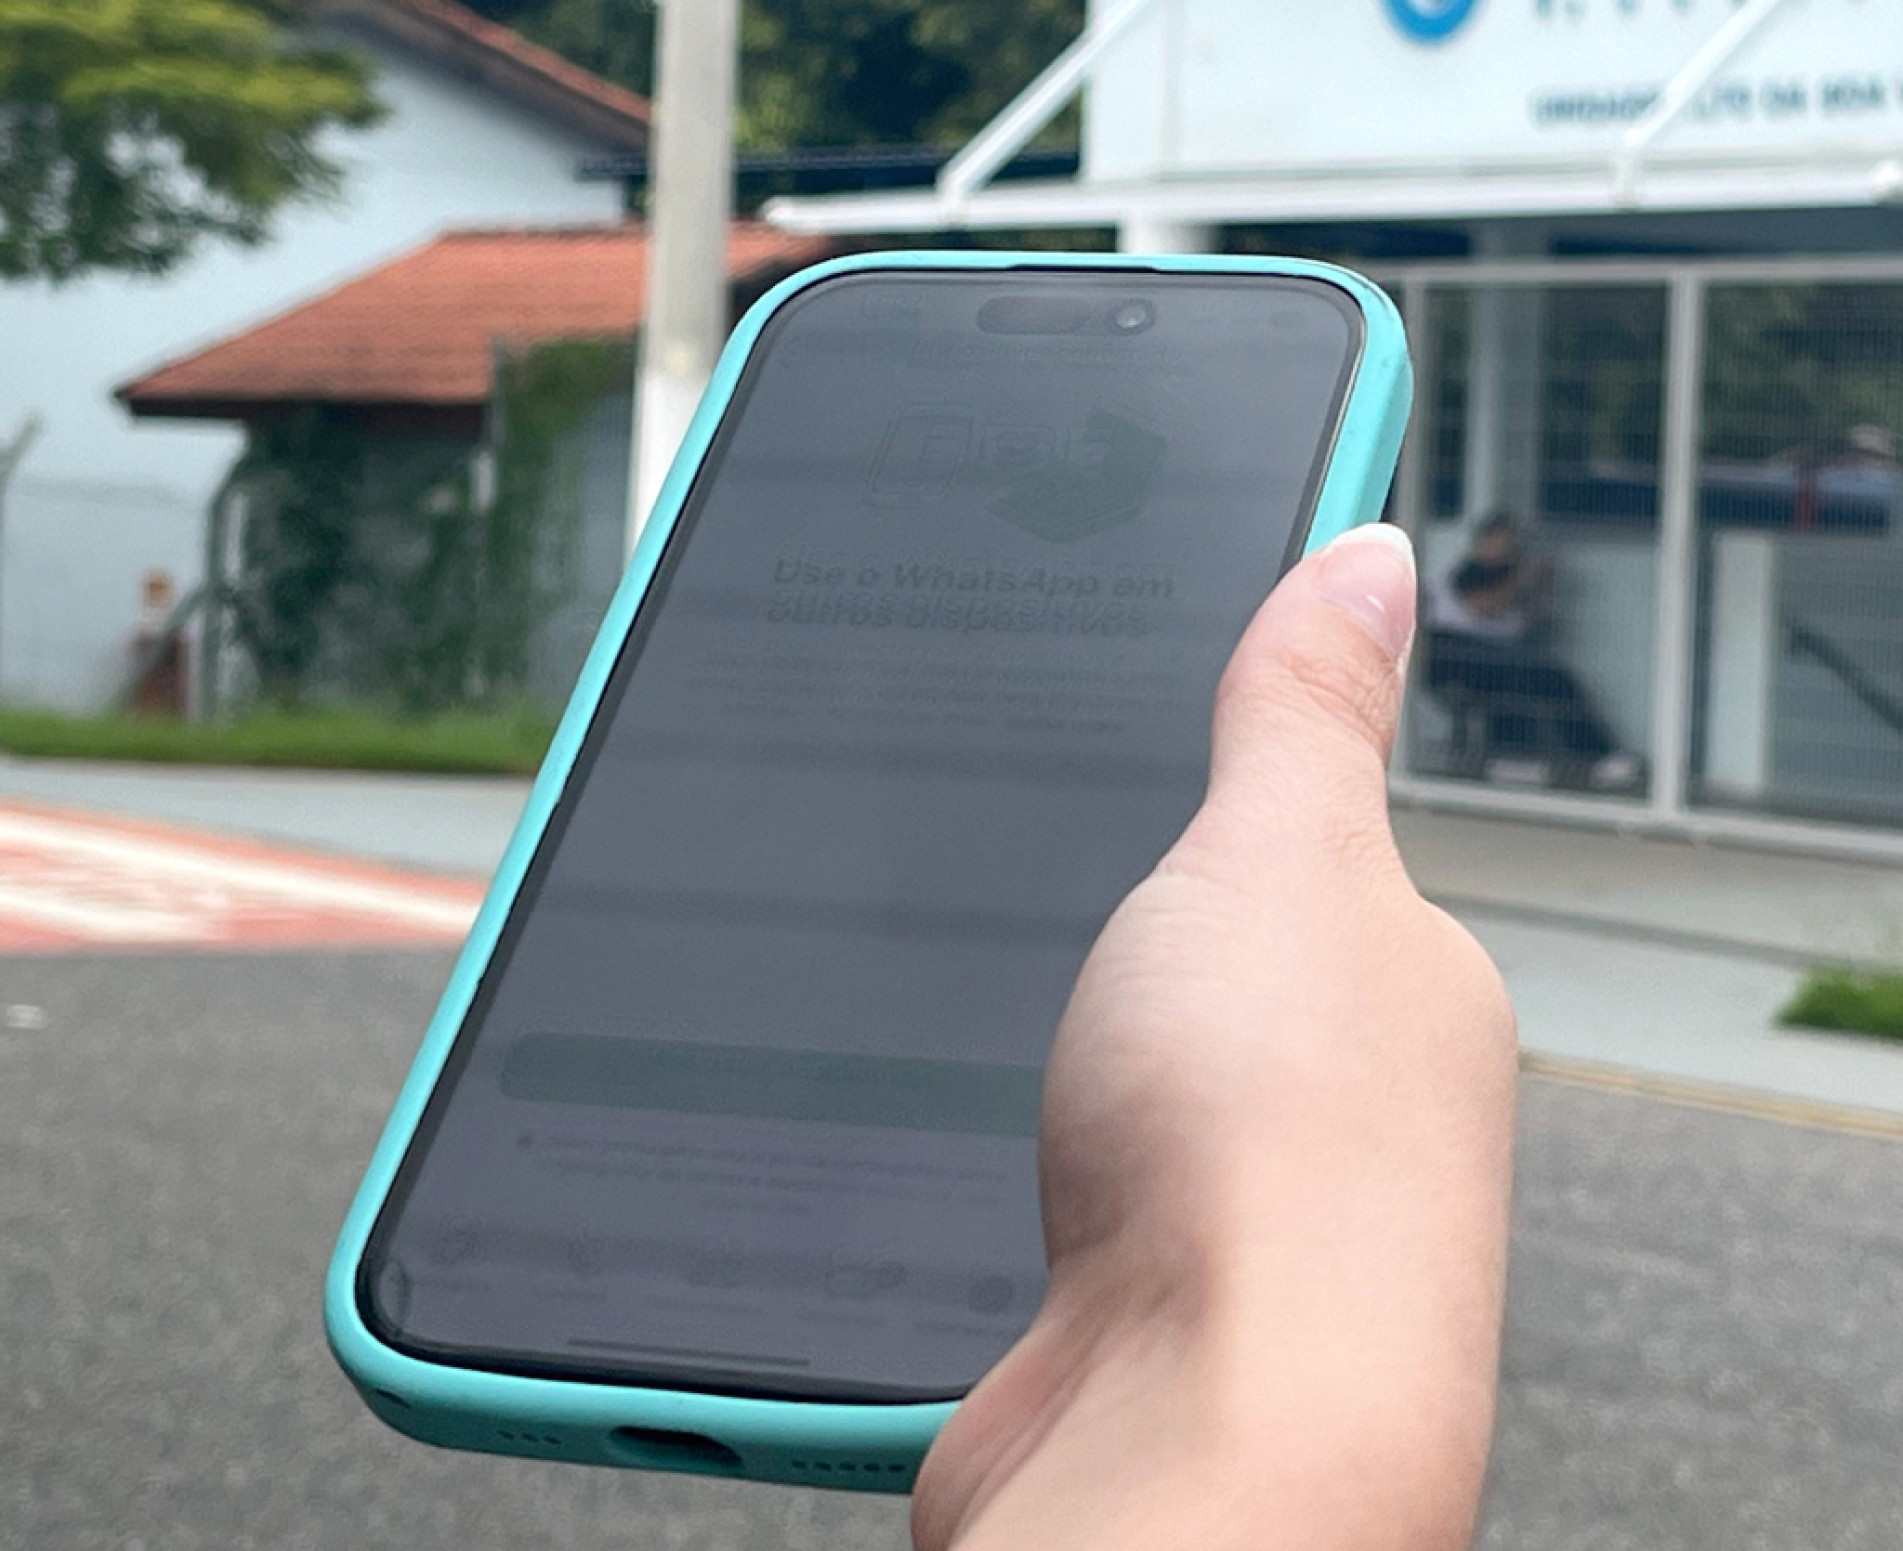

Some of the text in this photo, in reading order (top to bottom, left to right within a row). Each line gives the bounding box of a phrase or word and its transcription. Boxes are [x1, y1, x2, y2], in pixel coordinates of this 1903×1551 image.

[773, 558, 1176, 599] Use o WhatsApp em
[766, 597, 1160, 637] outros dispositivos
